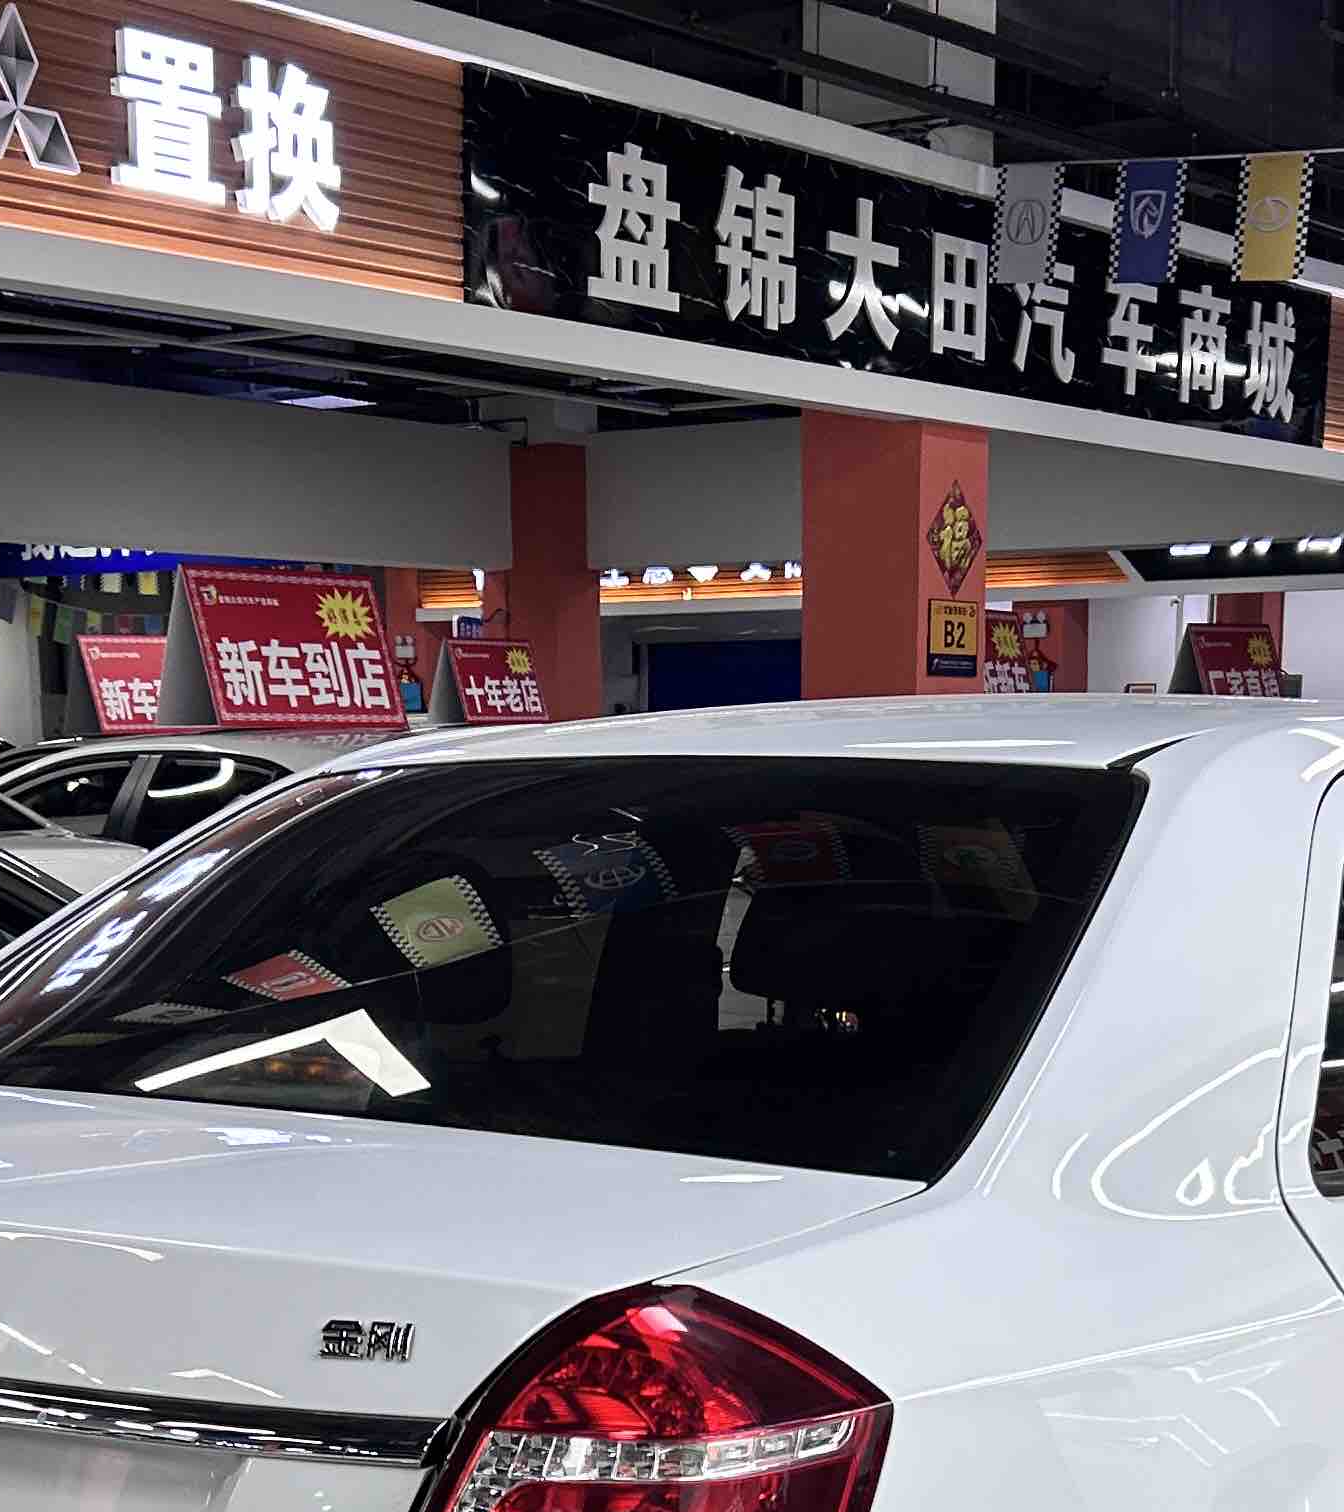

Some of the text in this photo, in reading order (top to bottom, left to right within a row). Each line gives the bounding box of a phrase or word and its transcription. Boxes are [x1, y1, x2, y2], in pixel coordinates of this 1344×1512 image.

[111, 27, 343, 231] 置换
[586, 144, 1298, 425] 盘锦大田汽车商城
[944, 620, 966, 648] B2
[215, 637, 392, 710] 新车到店
[464, 675, 543, 714] 十年老店
[99, 678, 161, 722] 新车
[319, 1319, 415, 1361] 金刚
